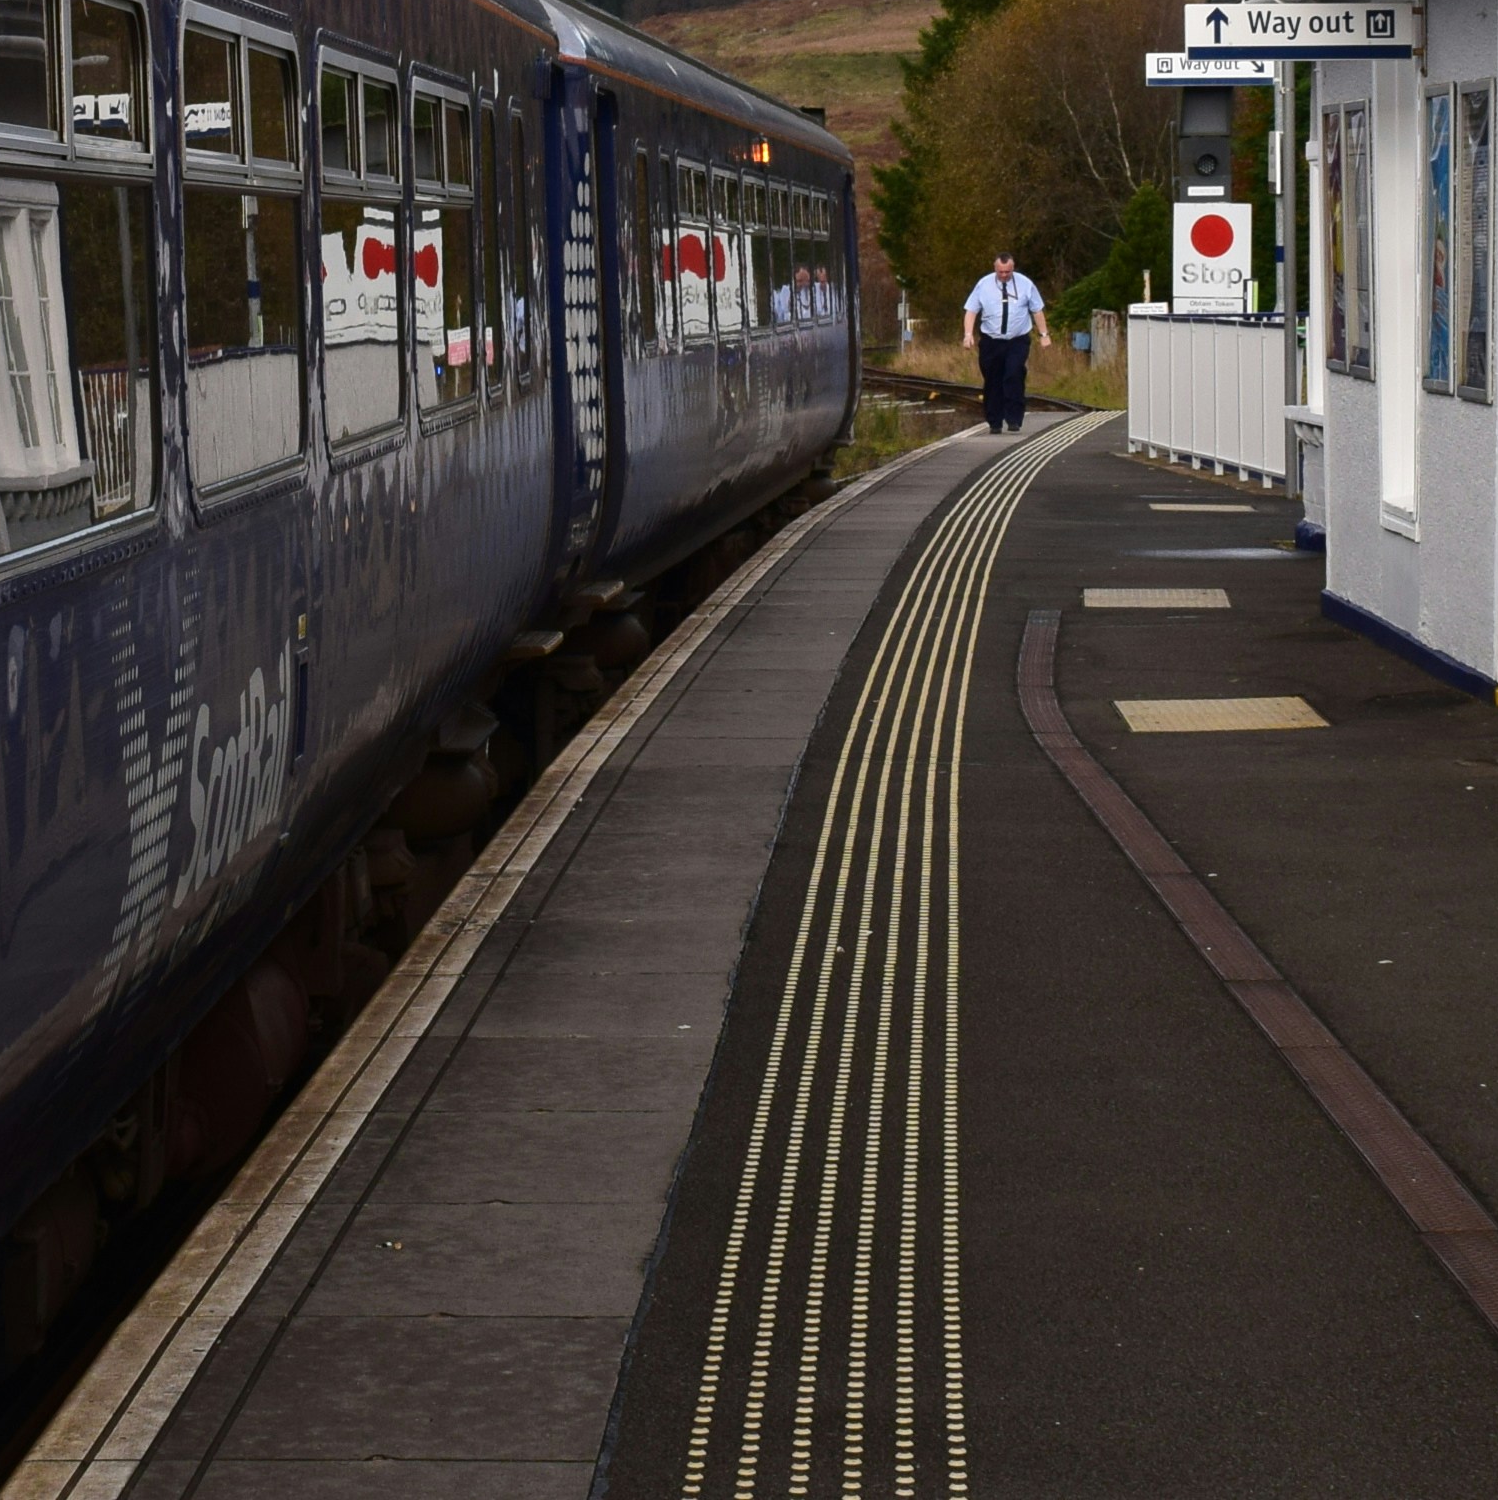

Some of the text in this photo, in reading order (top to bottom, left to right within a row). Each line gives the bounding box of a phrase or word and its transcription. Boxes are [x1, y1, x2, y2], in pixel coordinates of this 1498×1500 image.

[1247, 10, 1354, 40] Way out
[1179, 57, 1240, 74] Way out
[1181, 263, 1243, 288] Stop
[173, 636, 291, 909] ScotRail
